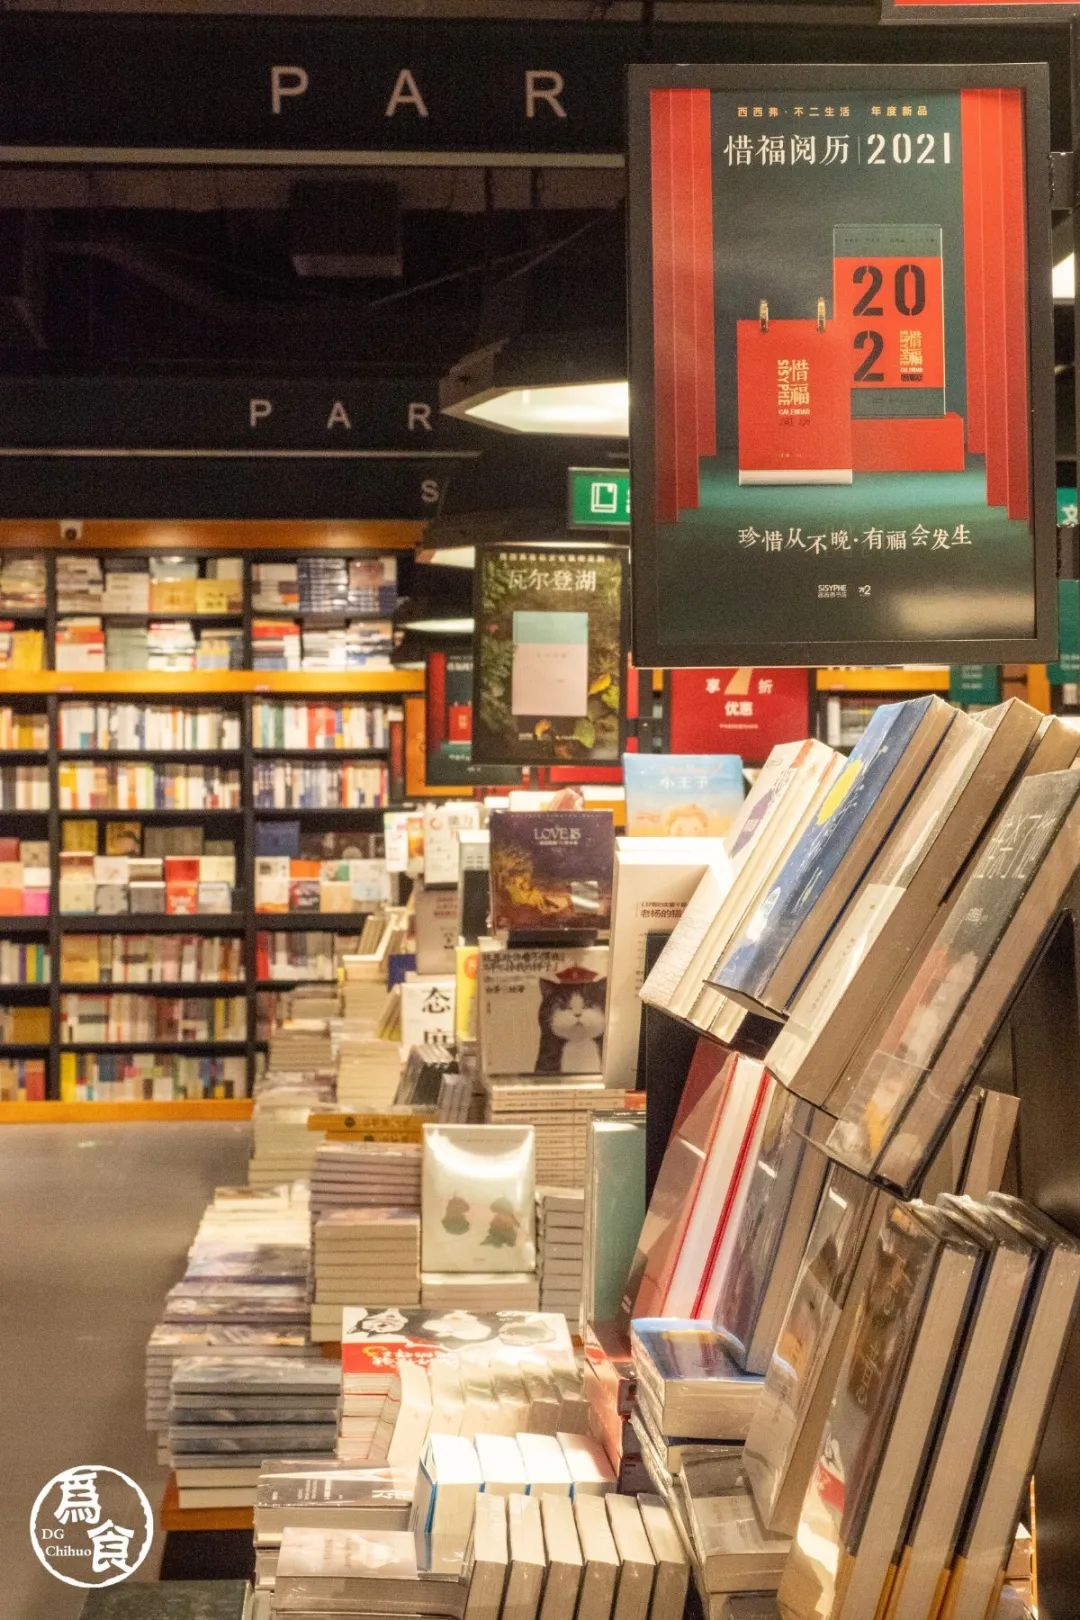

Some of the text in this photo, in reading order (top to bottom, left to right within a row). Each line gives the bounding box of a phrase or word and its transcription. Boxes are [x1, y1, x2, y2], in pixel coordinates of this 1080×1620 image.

[871, 105, 928, 116] 年度新品
[724, 132, 950, 166] 惜福阅历 2021
[508, 569, 597, 592] 瓦尔登湖
[725, 700, 753, 716] 优惠
[533, 825, 569, 840] LOVE
